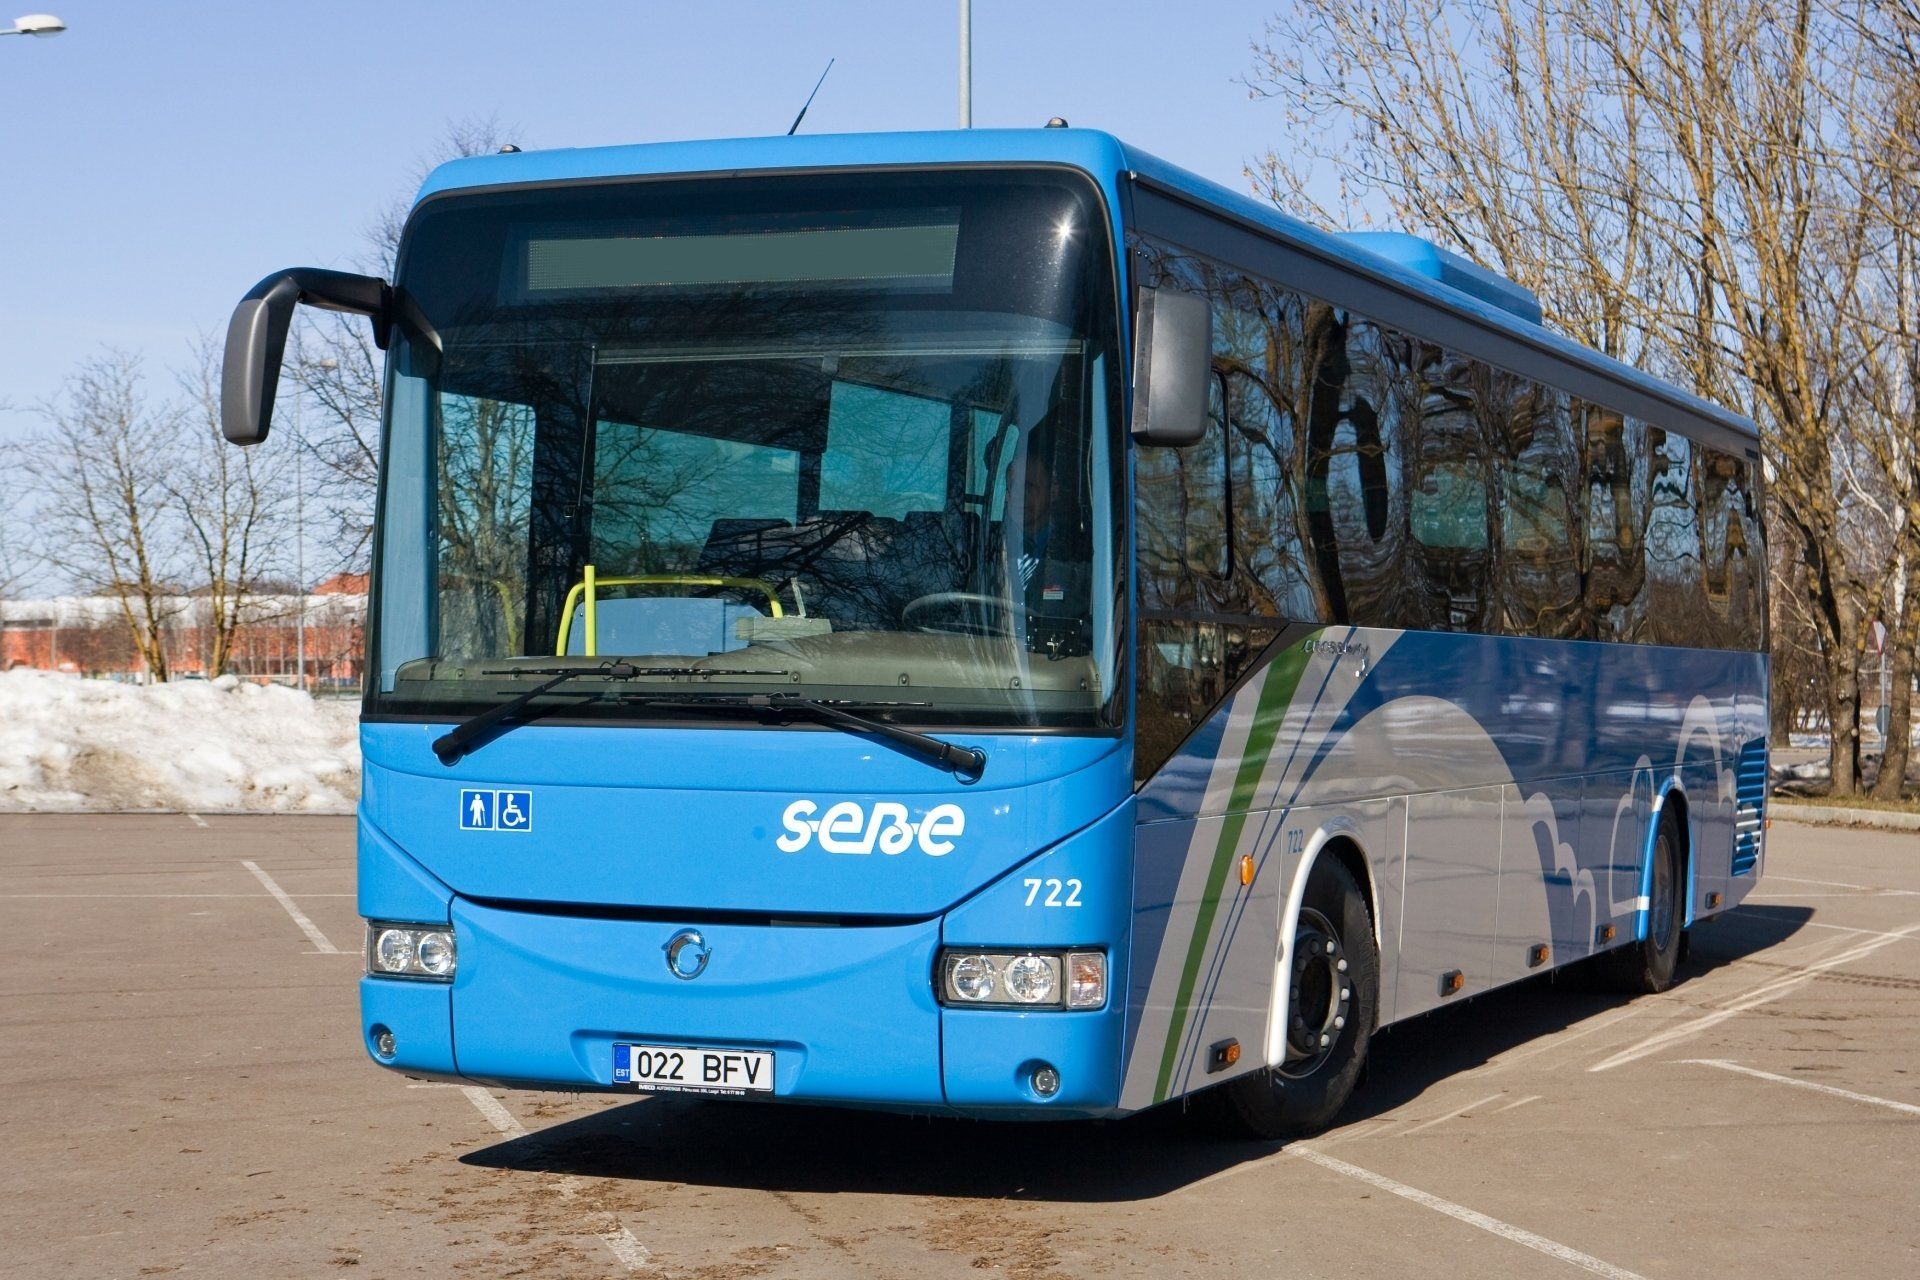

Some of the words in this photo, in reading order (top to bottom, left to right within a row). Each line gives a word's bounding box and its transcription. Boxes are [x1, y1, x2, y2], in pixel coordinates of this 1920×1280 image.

[1288, 829, 1303, 854] 722
[1023, 878, 1082, 907] 722
[616, 1068, 630, 1077] EST
[637, 1050, 684, 1080] 022
[703, 1054, 761, 1084] BFV
